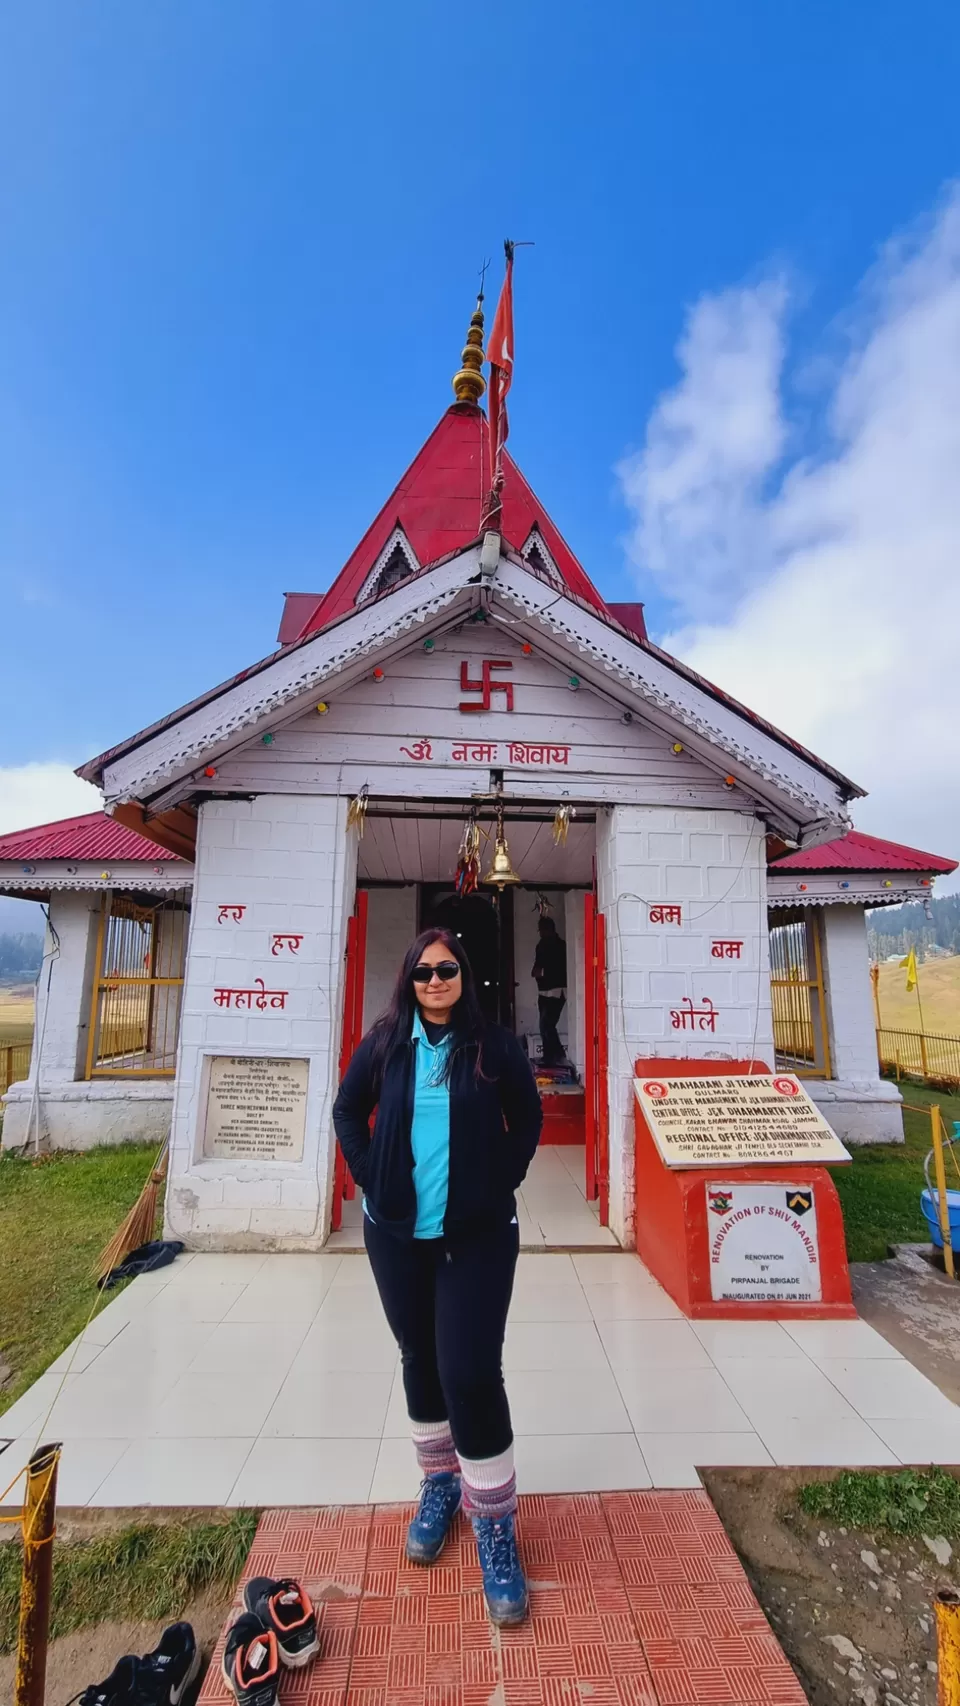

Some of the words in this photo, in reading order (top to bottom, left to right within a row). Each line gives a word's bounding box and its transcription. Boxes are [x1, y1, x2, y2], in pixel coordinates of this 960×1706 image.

[452, 742, 498, 762] नमः
[506, 742, 572, 765] शिवाय
[217, 905, 247, 925] हर
[650, 905, 682, 926] बम
[271, 934, 304, 956] हर
[711, 941, 744, 959] बम
[213, 978, 289, 1012] महादेव
[670, 997, 720, 1032] भोले
[668, 1080, 723, 1090] MAHARANI
[725, 1080, 735, 1088] JI
[735, 1079, 772, 1088] TEMPLE
[696, 1097, 740, 1105] MANAGEMENT
[652, 1109, 680, 1118] CENTRAL
[727, 1107, 786, 1116] DHARMARTH
[787, 1106, 814, 1114] TRUST
[665, 1134, 716, 1143] REGIONAL
[771, 1131, 813, 1141] DHARMARTH
[812, 1130, 834, 1140] TRUST
[712, 1207, 751, 1264] RENOVATION
[753, 1206, 766, 1214] OF
[768, 1207, 792, 1222] SHIV
[791, 1220, 817, 1264] MANDIR
